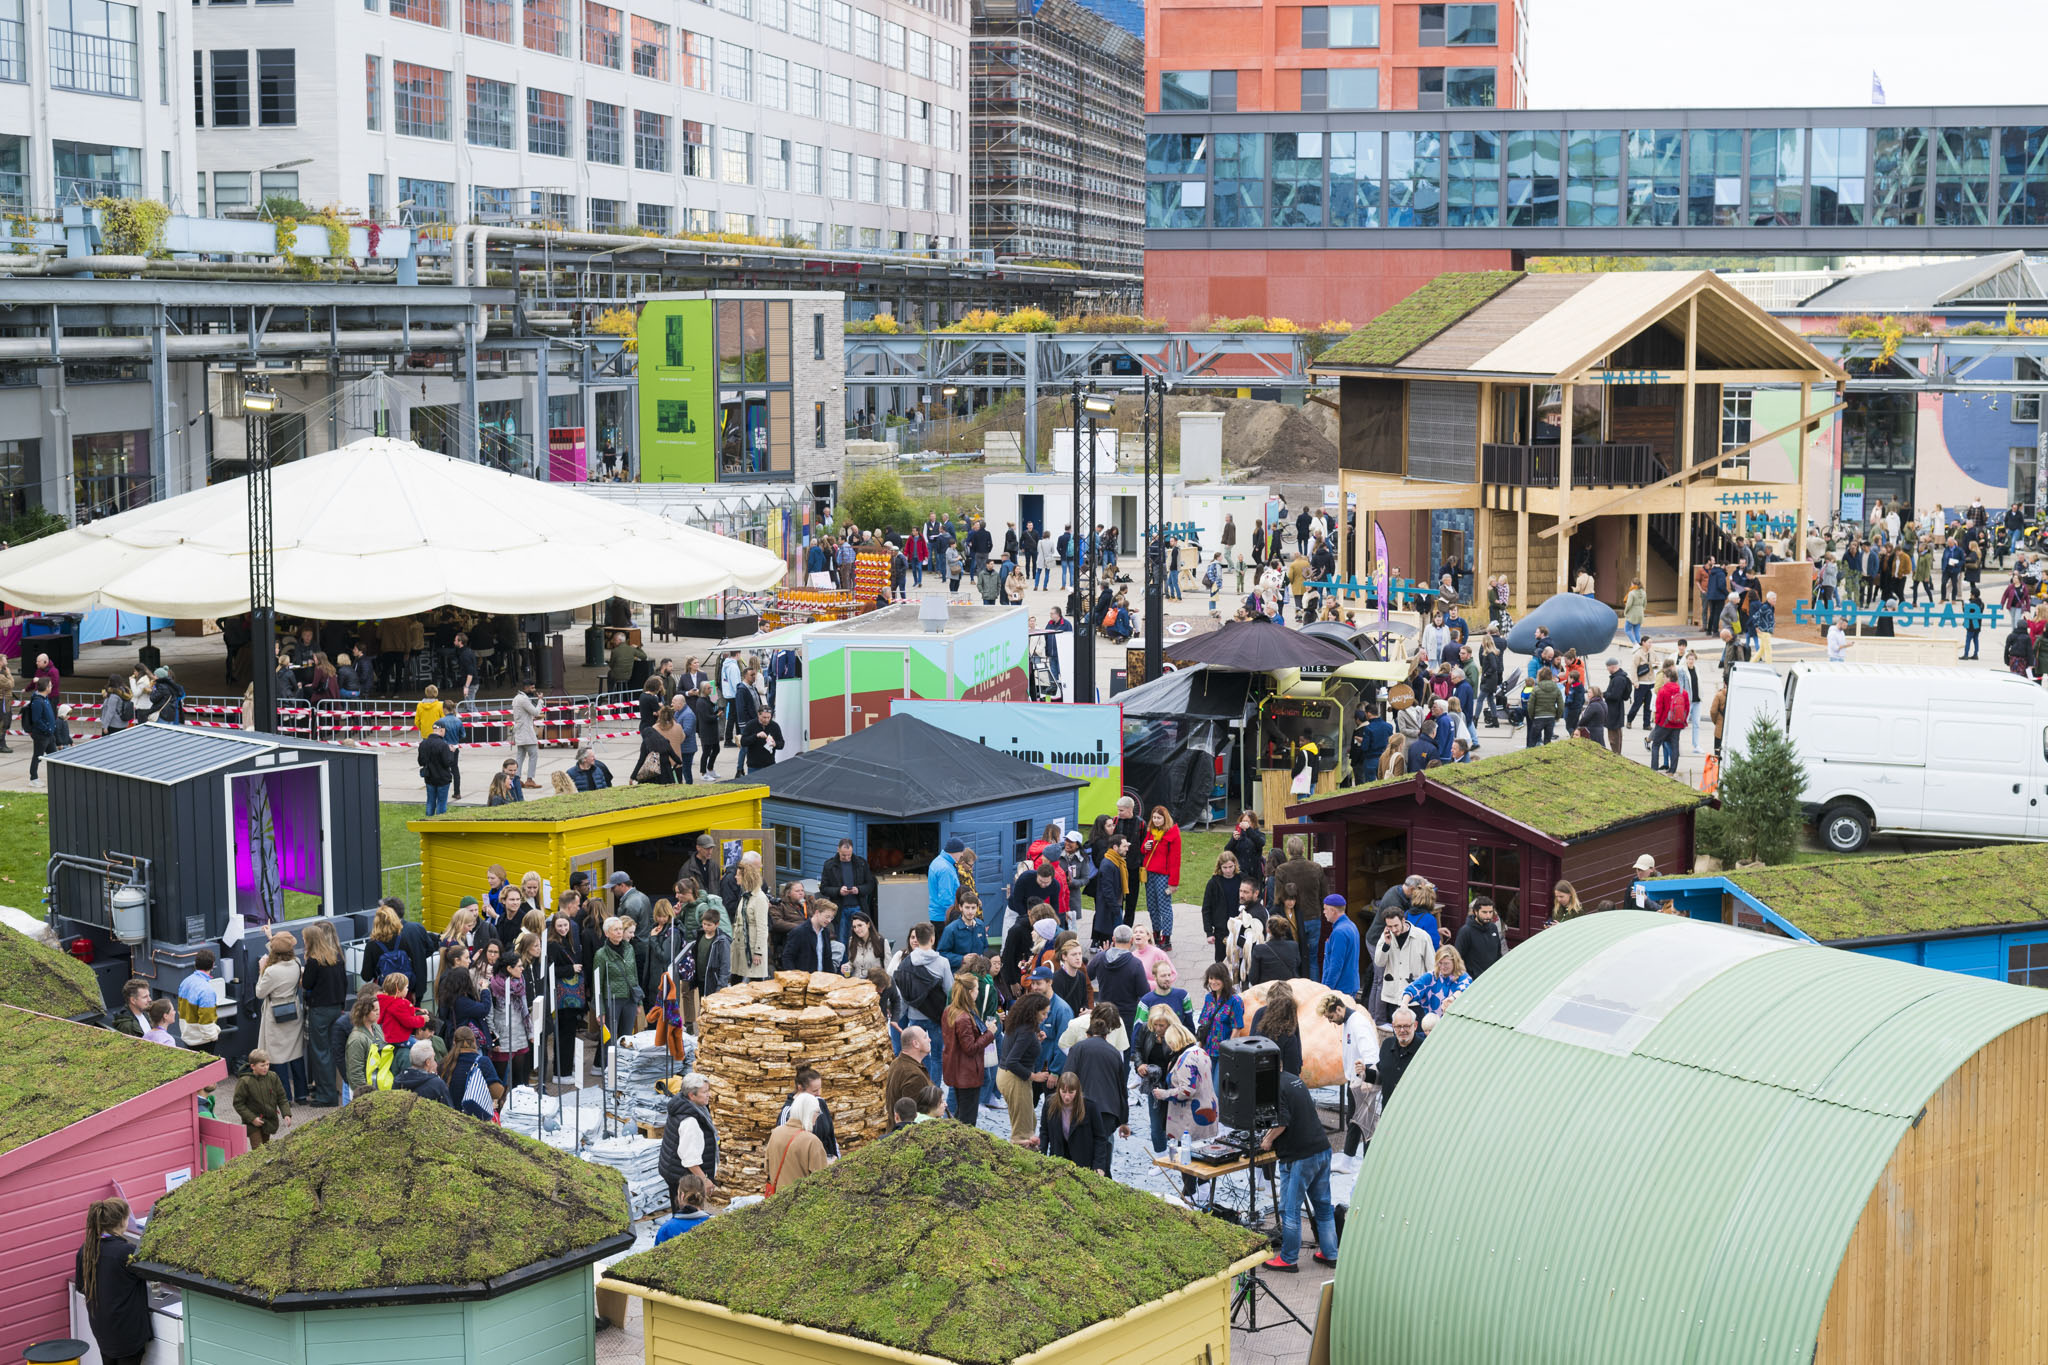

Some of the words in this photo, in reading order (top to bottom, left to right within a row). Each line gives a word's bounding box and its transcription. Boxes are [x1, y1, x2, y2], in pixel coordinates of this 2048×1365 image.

[1603, 370, 1658, 384] WATER
[1723, 491, 1770, 505] EARTH
[1796, 599, 1857, 625] END
[1898, 602, 2002, 629] START
